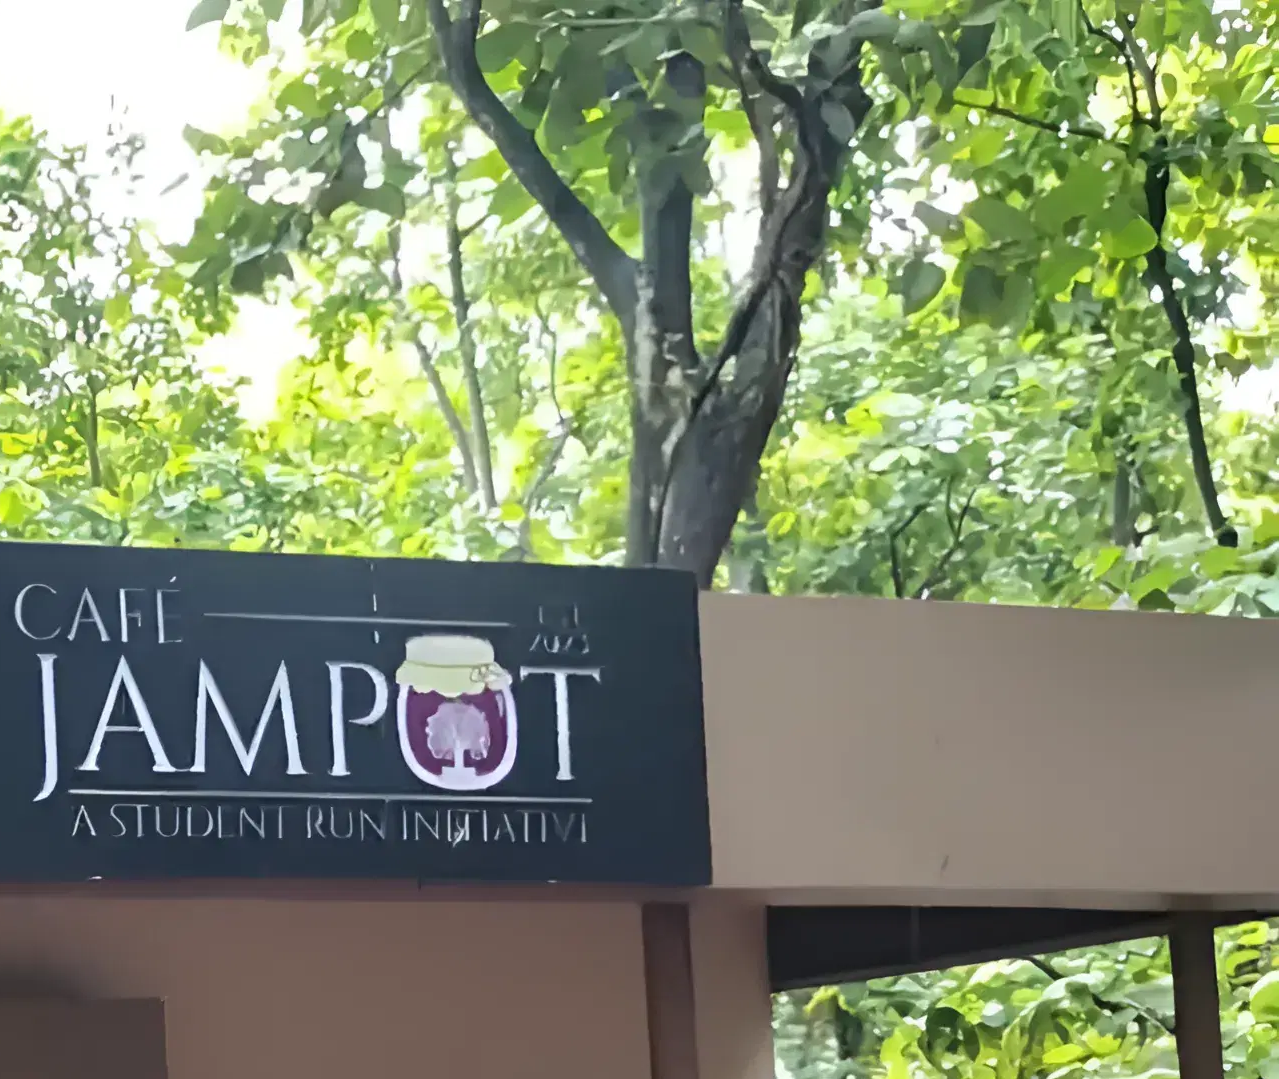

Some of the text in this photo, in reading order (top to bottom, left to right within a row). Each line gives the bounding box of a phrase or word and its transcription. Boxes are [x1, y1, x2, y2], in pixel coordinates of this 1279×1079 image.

[13, 576, 184, 644] CAFÉ
[32, 636, 602, 802] JAMPOT
[71, 803, 98, 837] A
[109, 803, 293, 839] STUDENT
[305, 805, 386, 840] RUN
